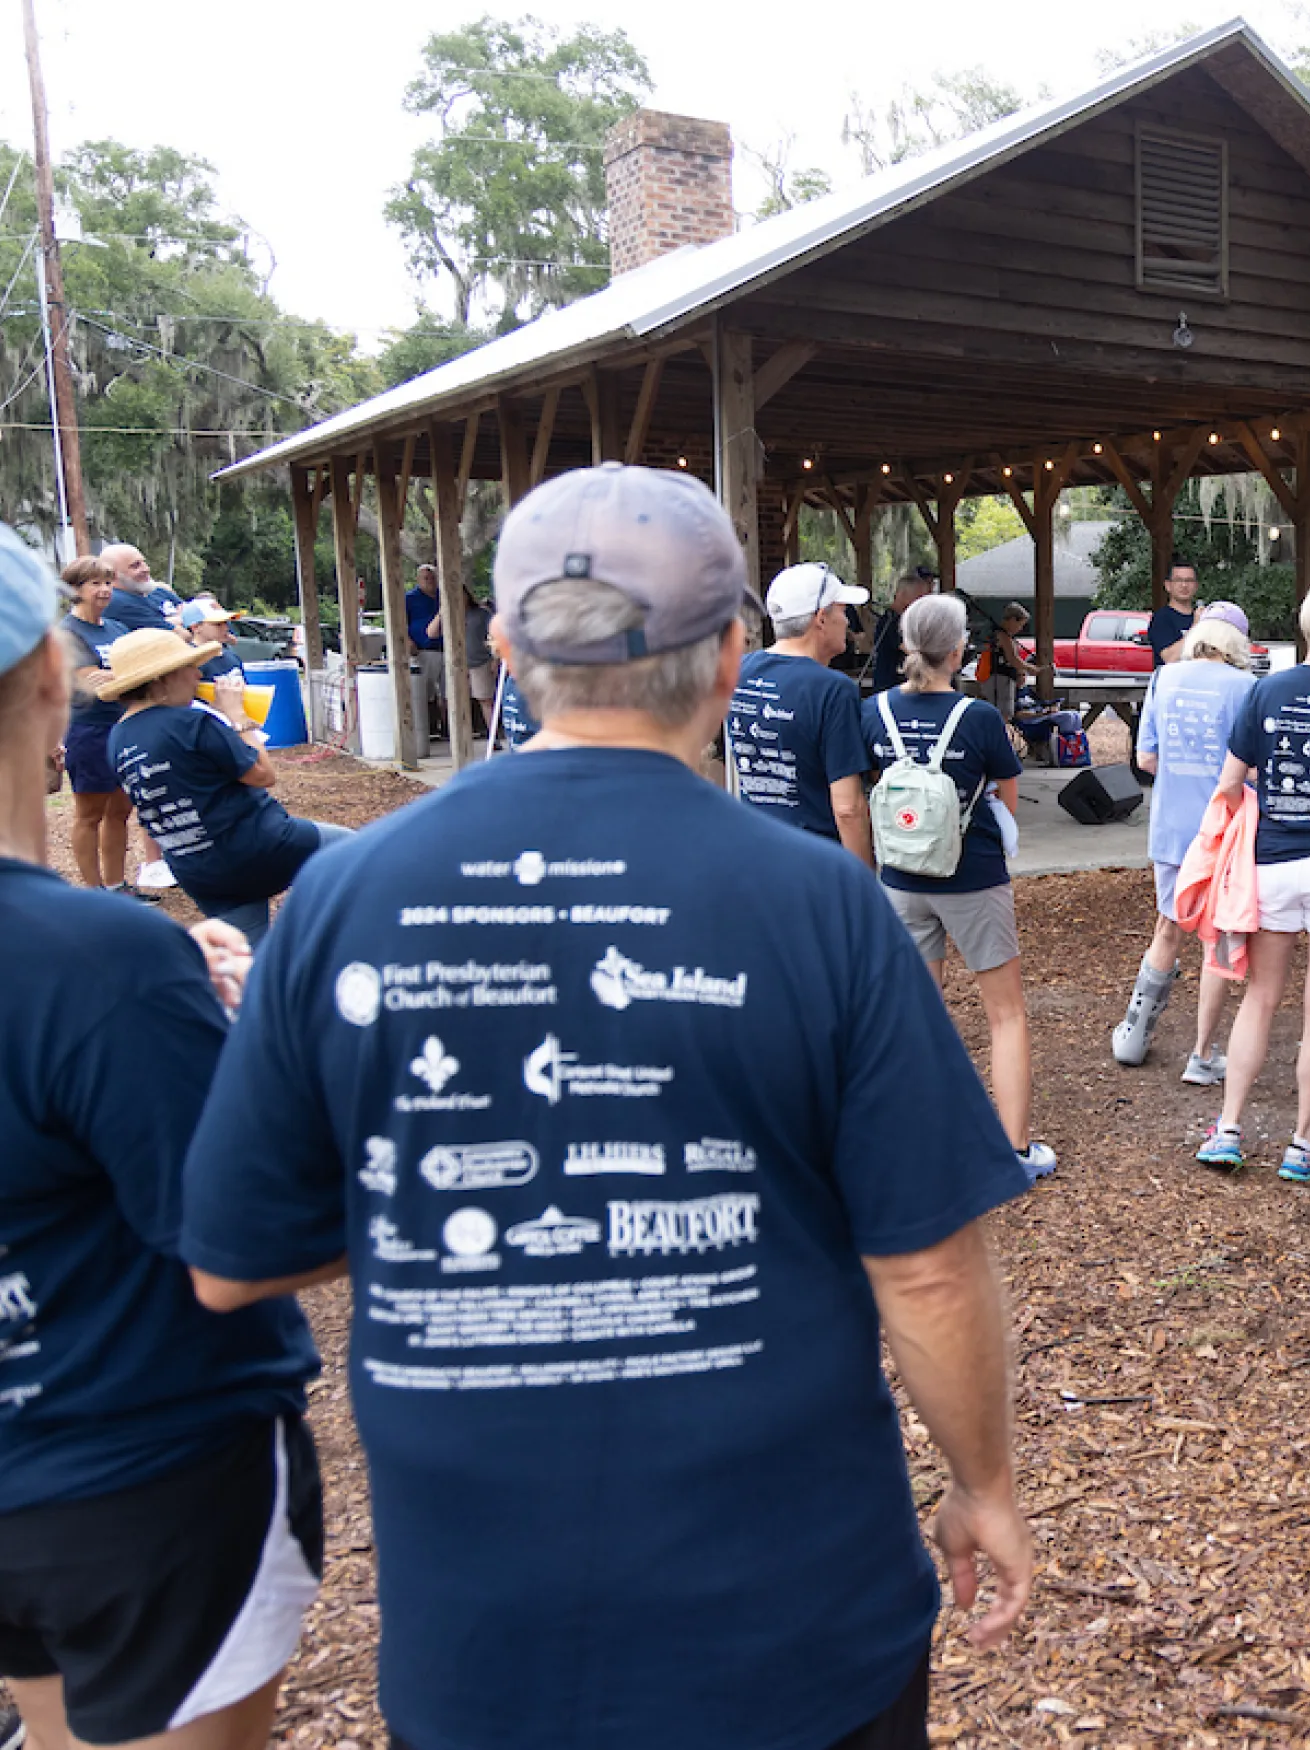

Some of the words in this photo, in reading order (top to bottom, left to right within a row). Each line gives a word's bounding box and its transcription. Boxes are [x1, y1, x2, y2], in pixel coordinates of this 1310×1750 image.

[461, 860, 511, 878] water
[400, 906, 448, 926] 2024
[452, 905, 556, 925] SPONSORS
[570, 905, 671, 926] BEAUFORT
[383, 964, 422, 986] First
[426, 959, 551, 988] Presbyterian
[672, 966, 748, 996] Island
[385, 985, 452, 1011] Church
[472, 982, 558, 1007] Beaufort
[607, 1193, 761, 1249] BEAUFORT
